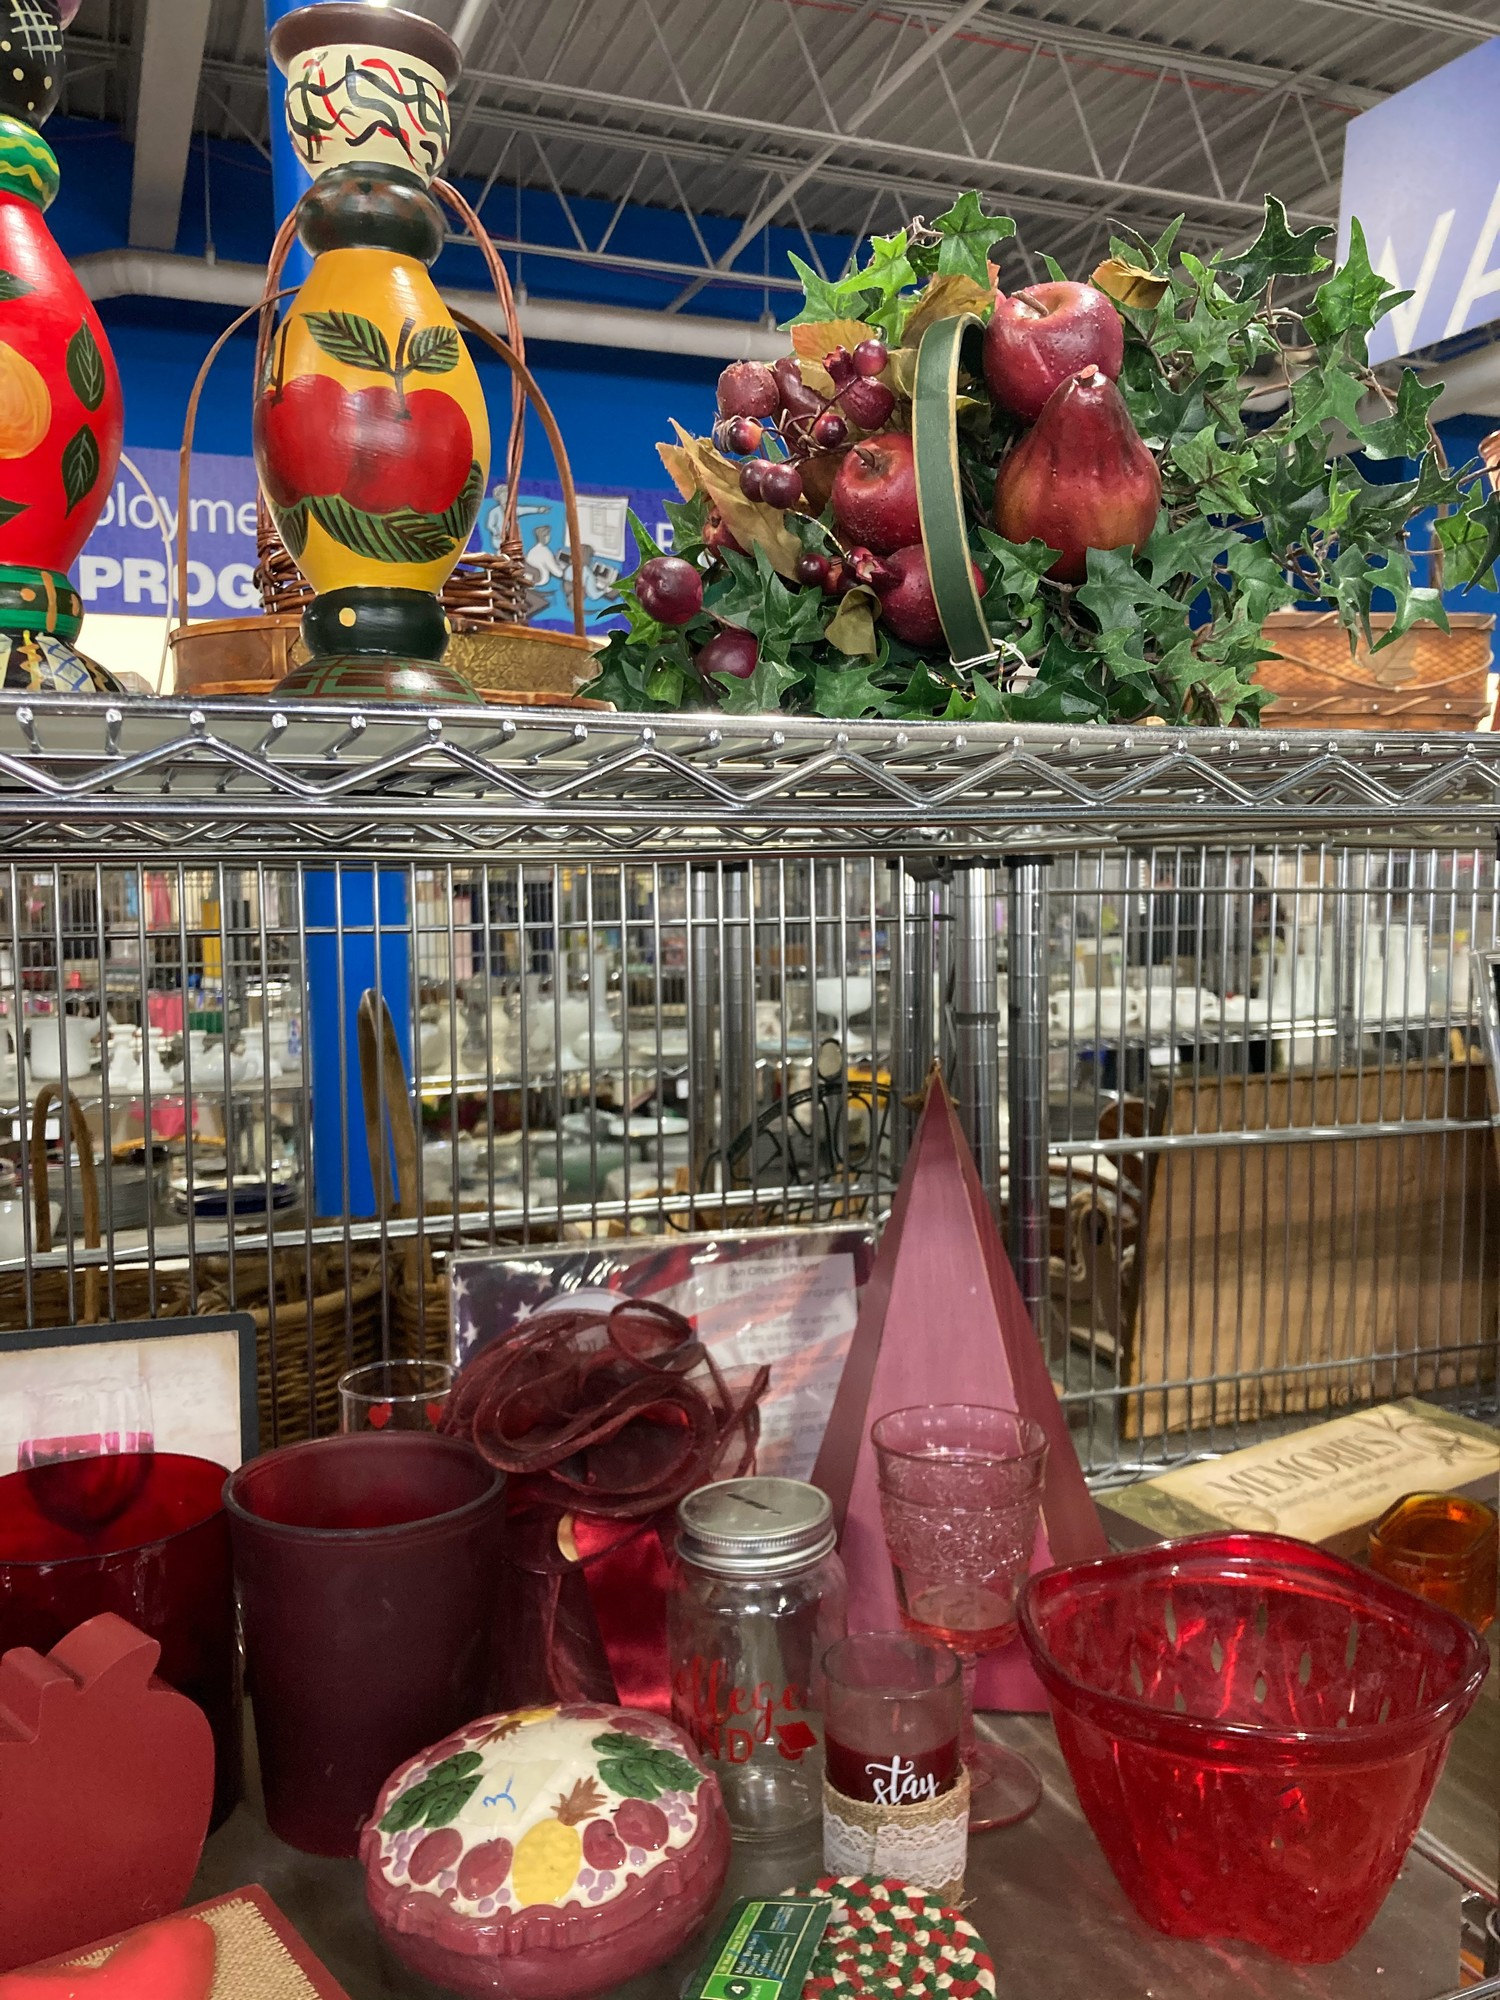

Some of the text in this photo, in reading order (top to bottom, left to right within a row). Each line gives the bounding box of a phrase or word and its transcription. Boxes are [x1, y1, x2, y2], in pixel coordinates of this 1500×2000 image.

[79, 555, 264, 609] PROG
[1206, 1432, 1402, 1498] MEMORIES
[865, 1755, 940, 1806] stay
[731, 1985, 745, 1994] 4
